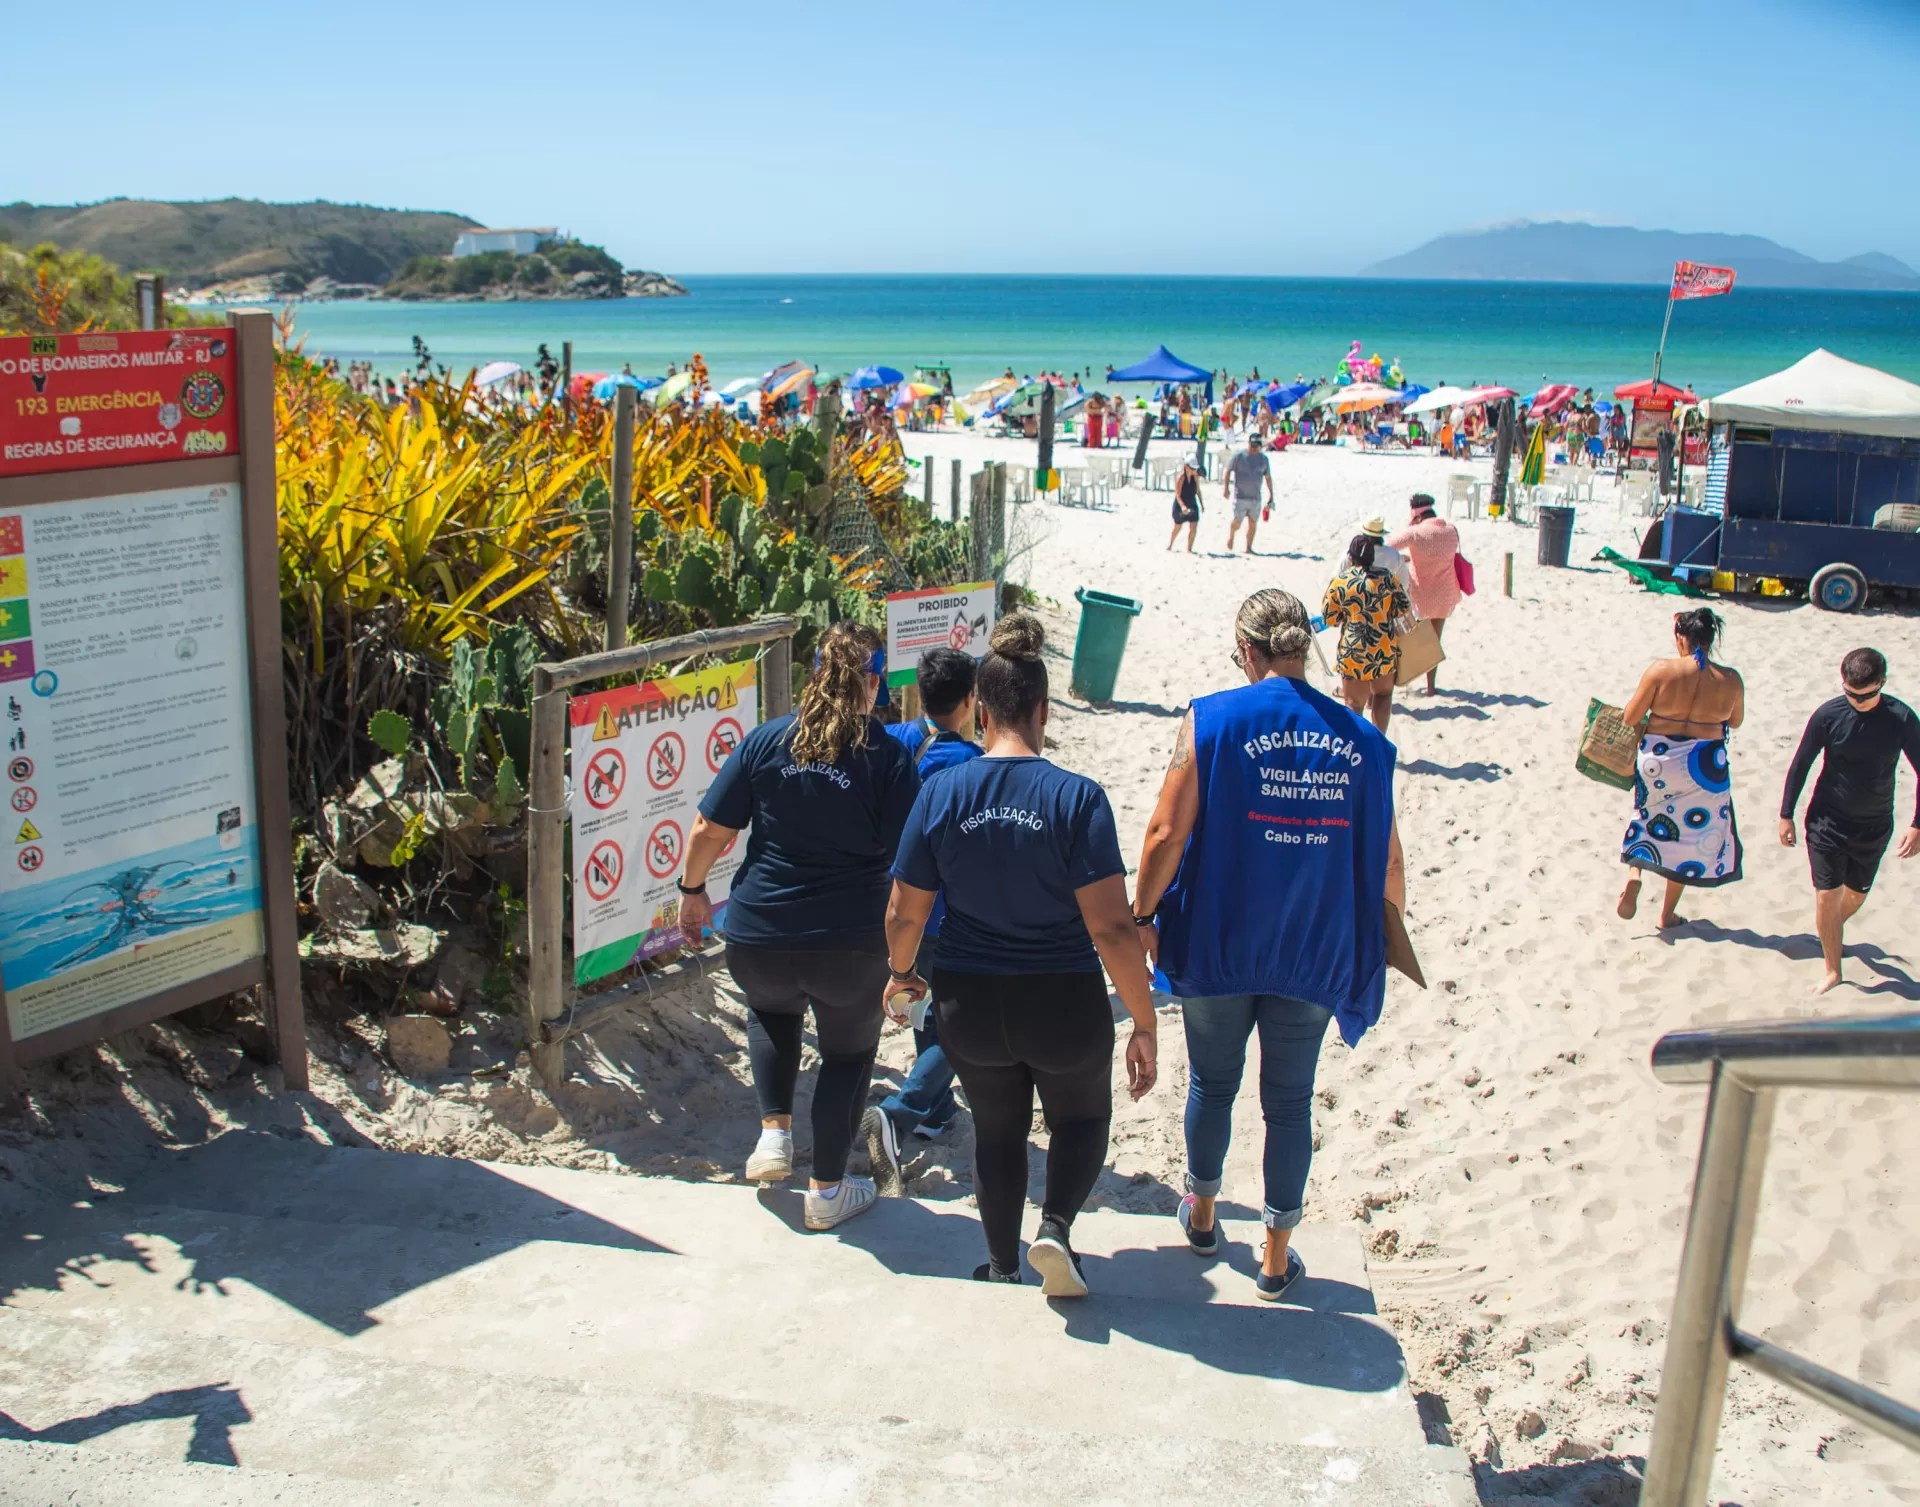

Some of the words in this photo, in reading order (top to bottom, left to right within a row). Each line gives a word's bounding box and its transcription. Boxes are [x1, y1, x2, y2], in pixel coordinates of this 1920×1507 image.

[0, 359, 16, 374] O
[20, 358, 40, 374] DE
[43, 352, 128, 372] BOMBEIROS
[131, 349, 184, 368] MILITAR
[196, 348, 211, 363] RJ
[16, 398, 49, 417] 193
[56, 390, 164, 414] EMERGÊNCIA
[4, 441, 64, 460] REGRAS
[66, 439, 86, 453] DE
[87, 430, 178, 452] SEGURANÇA
[918, 596, 968, 613] PROIBIDO
[896, 617, 927, 627] ALIMENTAR
[927, 615, 940, 623] AVES
[896, 625, 919, 634] ANIMAIS
[920, 621, 949, 631] SILVESTRES
[617, 685, 720, 730] ATENÇÃO
[1243, 730, 1363, 767] FISCALIZAÇÃO
[780, 761, 851, 790] FISCALIZAÇÃO
[1259, 767, 1350, 785] VIGILÂNCIA
[1261, 783, 1345, 801] SANITÁRIA
[959, 806, 1044, 835] FISCALIZAÇÃO
[1264, 829, 1301, 844] Cabo
[1305, 833, 1329, 845] Frio
